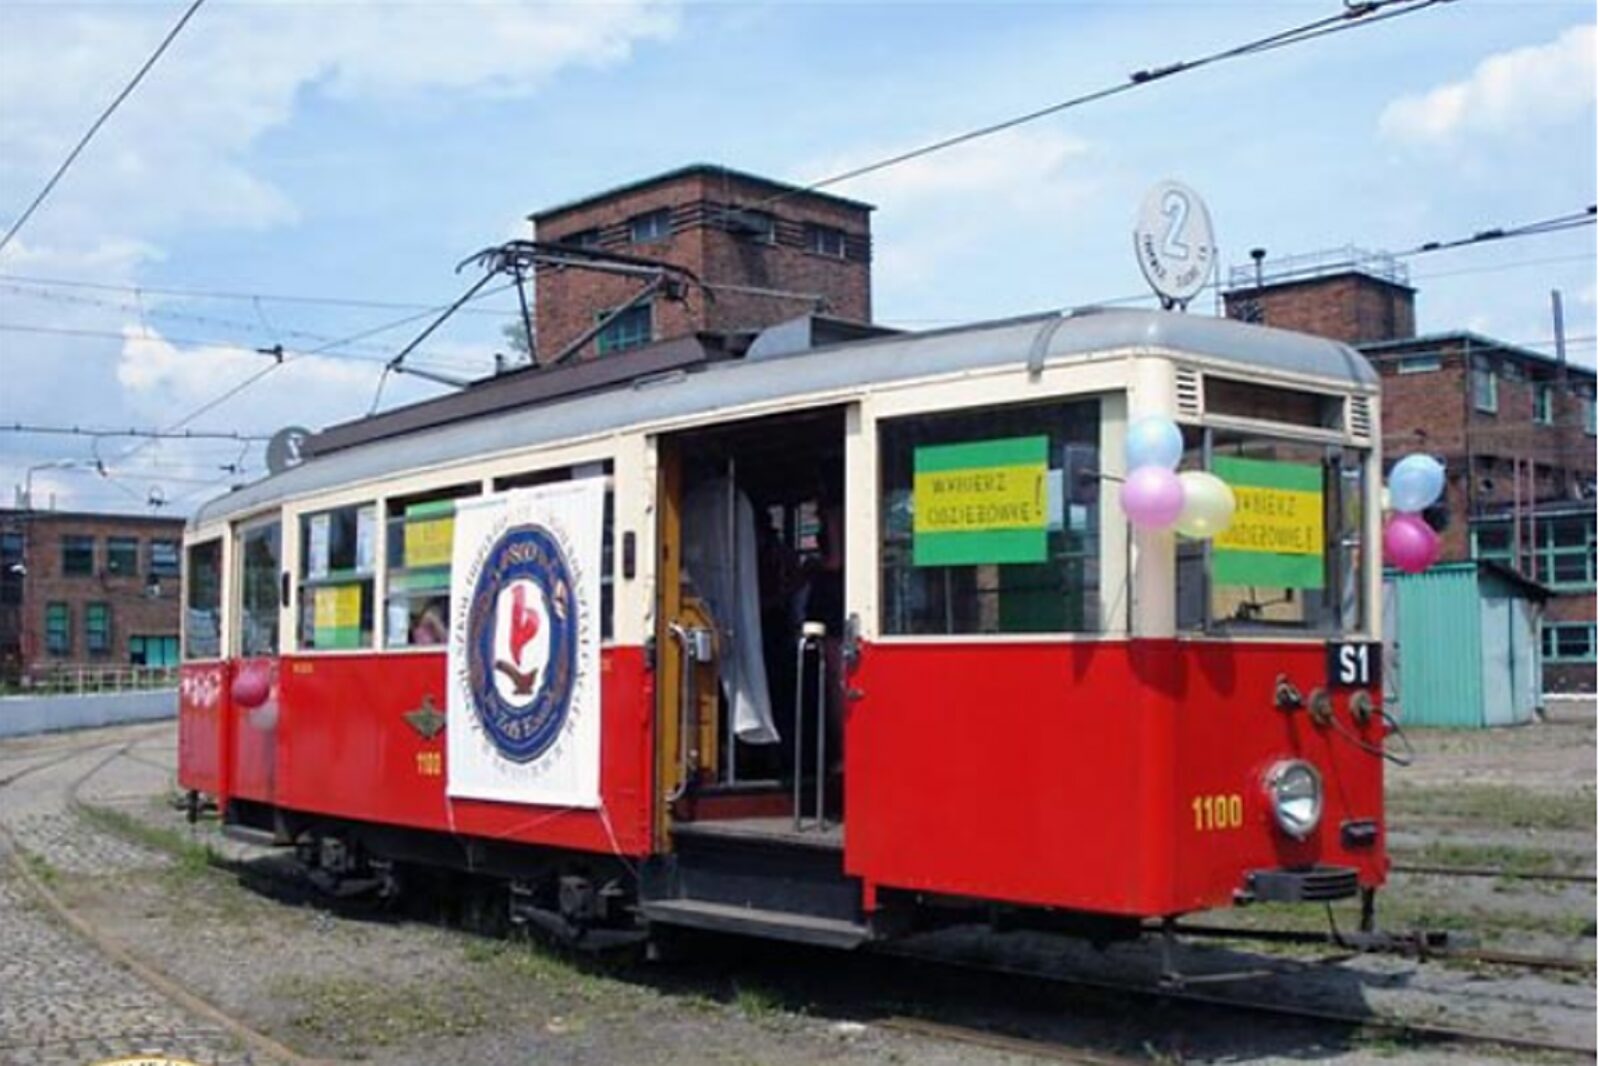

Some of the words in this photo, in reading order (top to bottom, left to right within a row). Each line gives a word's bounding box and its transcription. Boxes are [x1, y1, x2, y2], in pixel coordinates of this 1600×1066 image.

[1160, 189, 1189, 261] 2
[1339, 644, 1370, 683] S1
[416, 751, 441, 777] 1100
[1192, 793, 1243, 831] 1100
